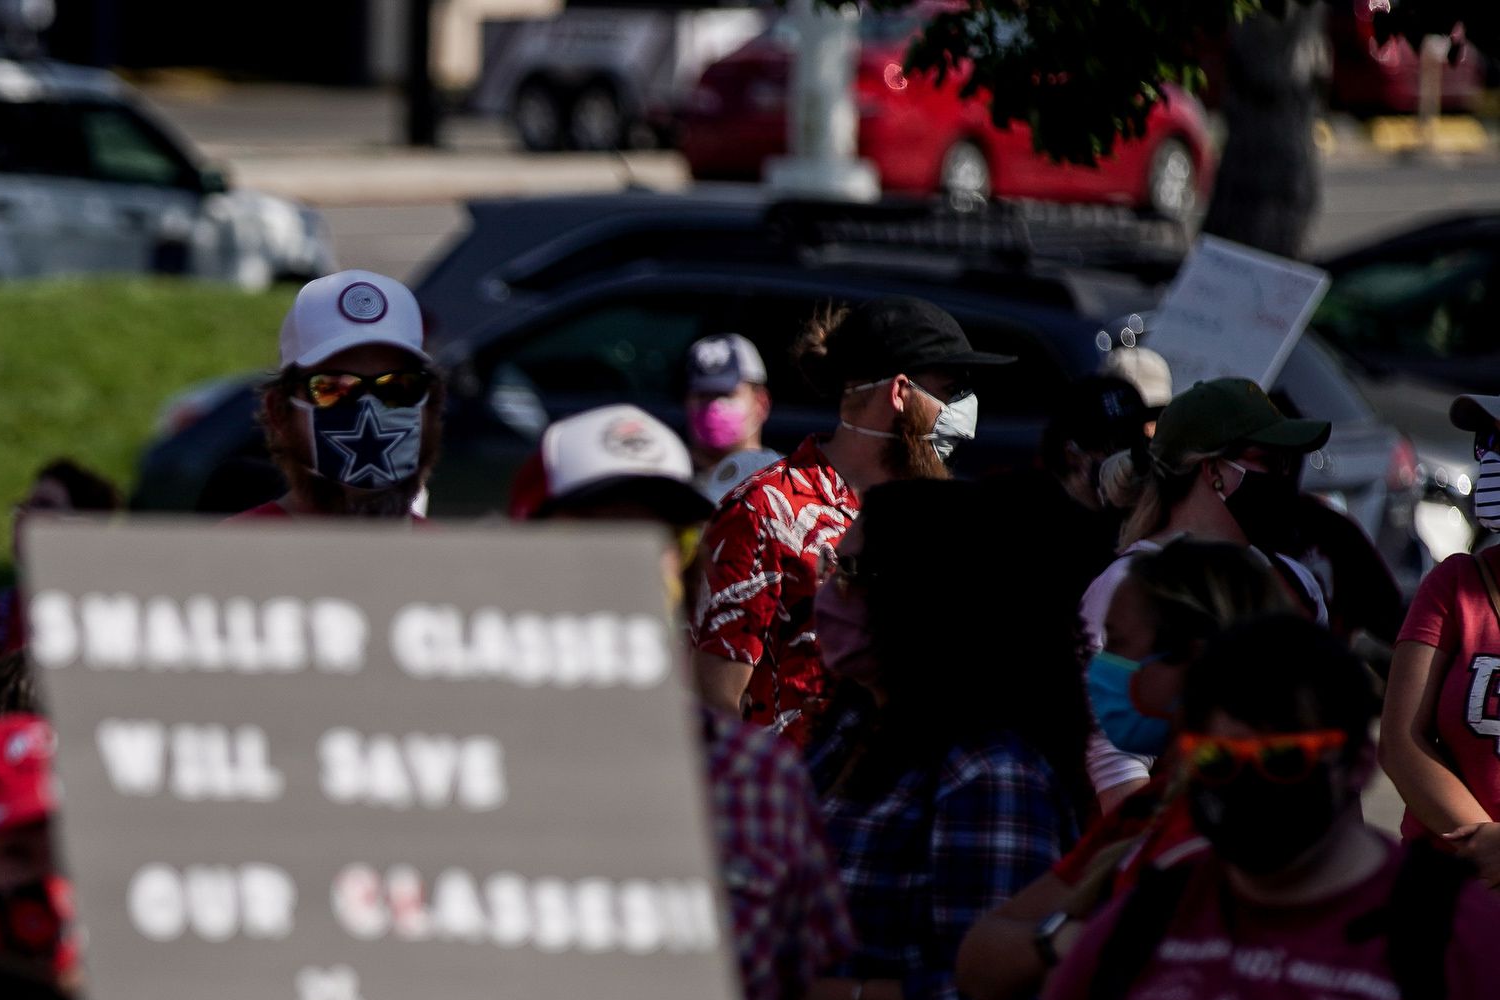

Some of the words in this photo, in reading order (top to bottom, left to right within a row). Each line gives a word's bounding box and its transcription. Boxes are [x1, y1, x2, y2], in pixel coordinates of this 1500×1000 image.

[28, 590, 368, 674] SMALLER
[390, 603, 672, 690] CLASSES
[98, 717, 282, 800] WILL
[318, 727, 506, 810] SAVE
[126, 861, 296, 942] OUR
